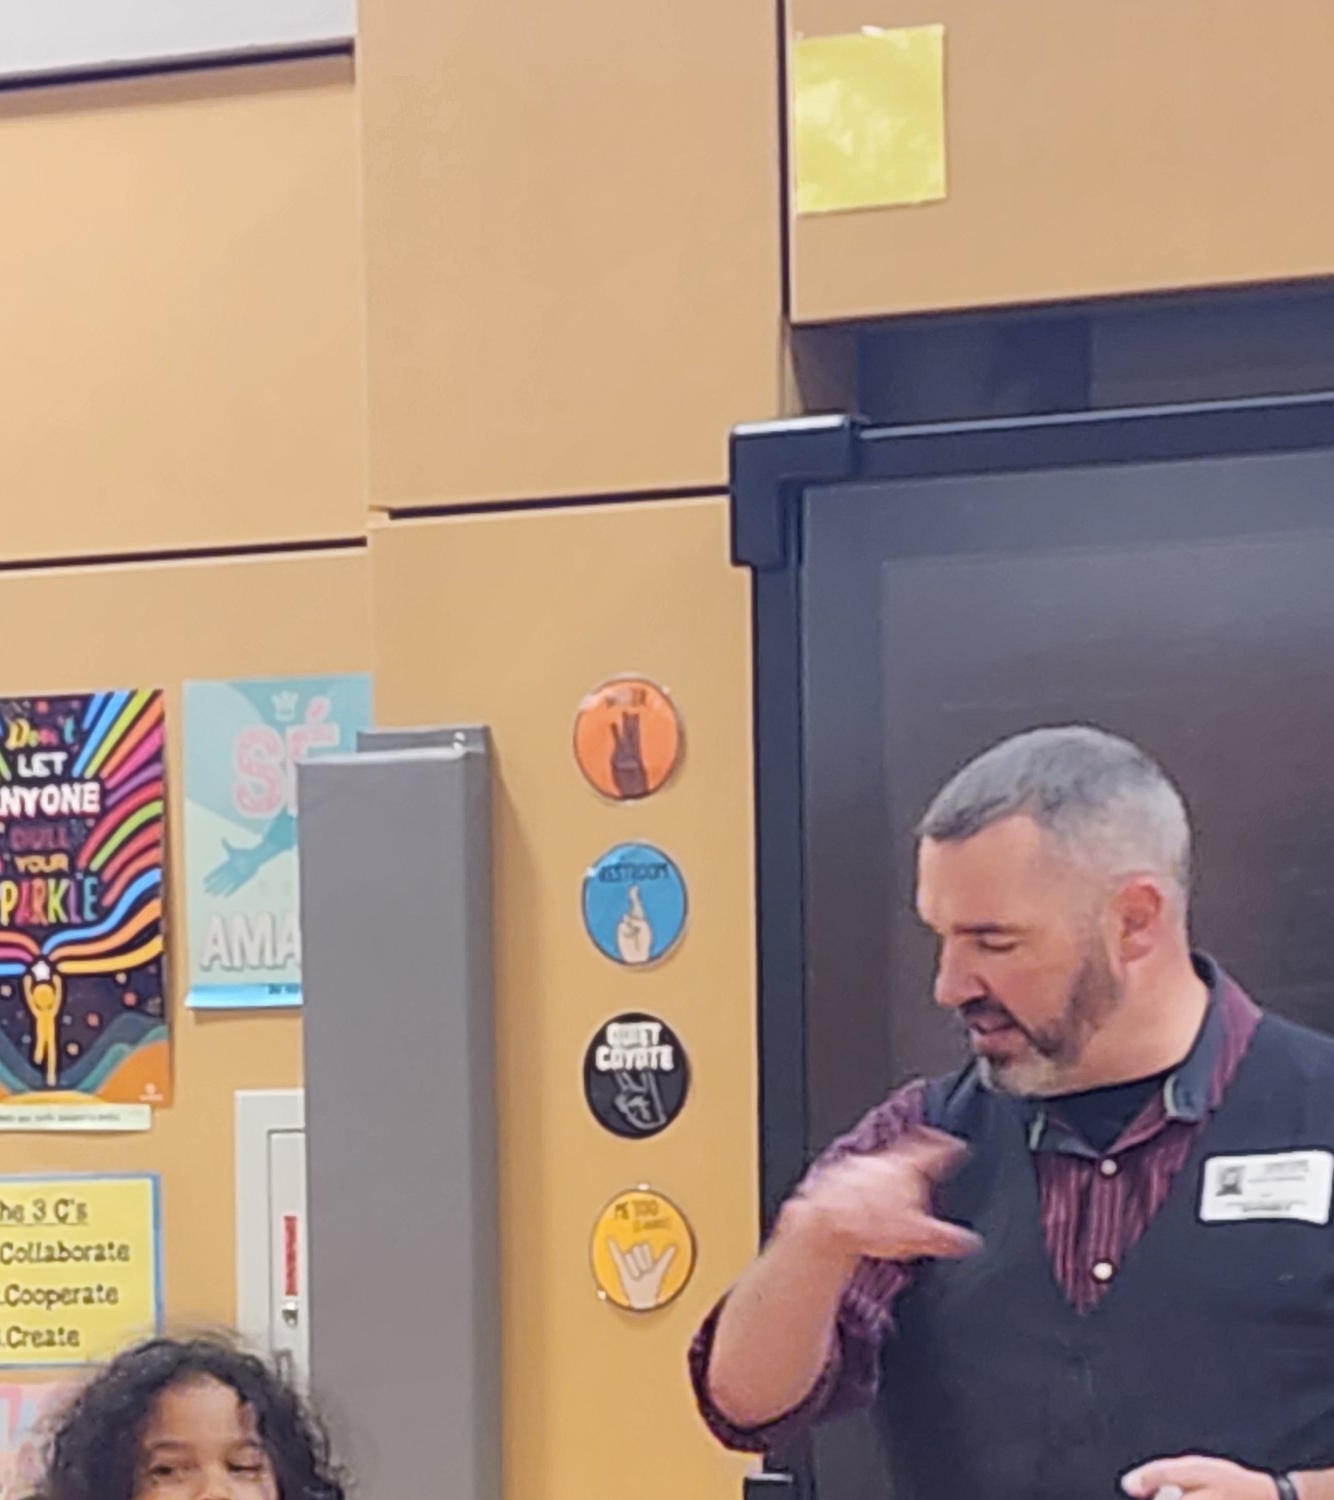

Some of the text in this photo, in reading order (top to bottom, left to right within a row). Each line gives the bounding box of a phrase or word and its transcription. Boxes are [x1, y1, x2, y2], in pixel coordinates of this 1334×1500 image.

[17, 752, 69, 778] LET
[14, 853, 69, 873] YOUR
[595, 1045, 674, 1071] COYOTE
[33, 1198, 46, 1222] 3
[54, 1198, 88, 1222] C's
